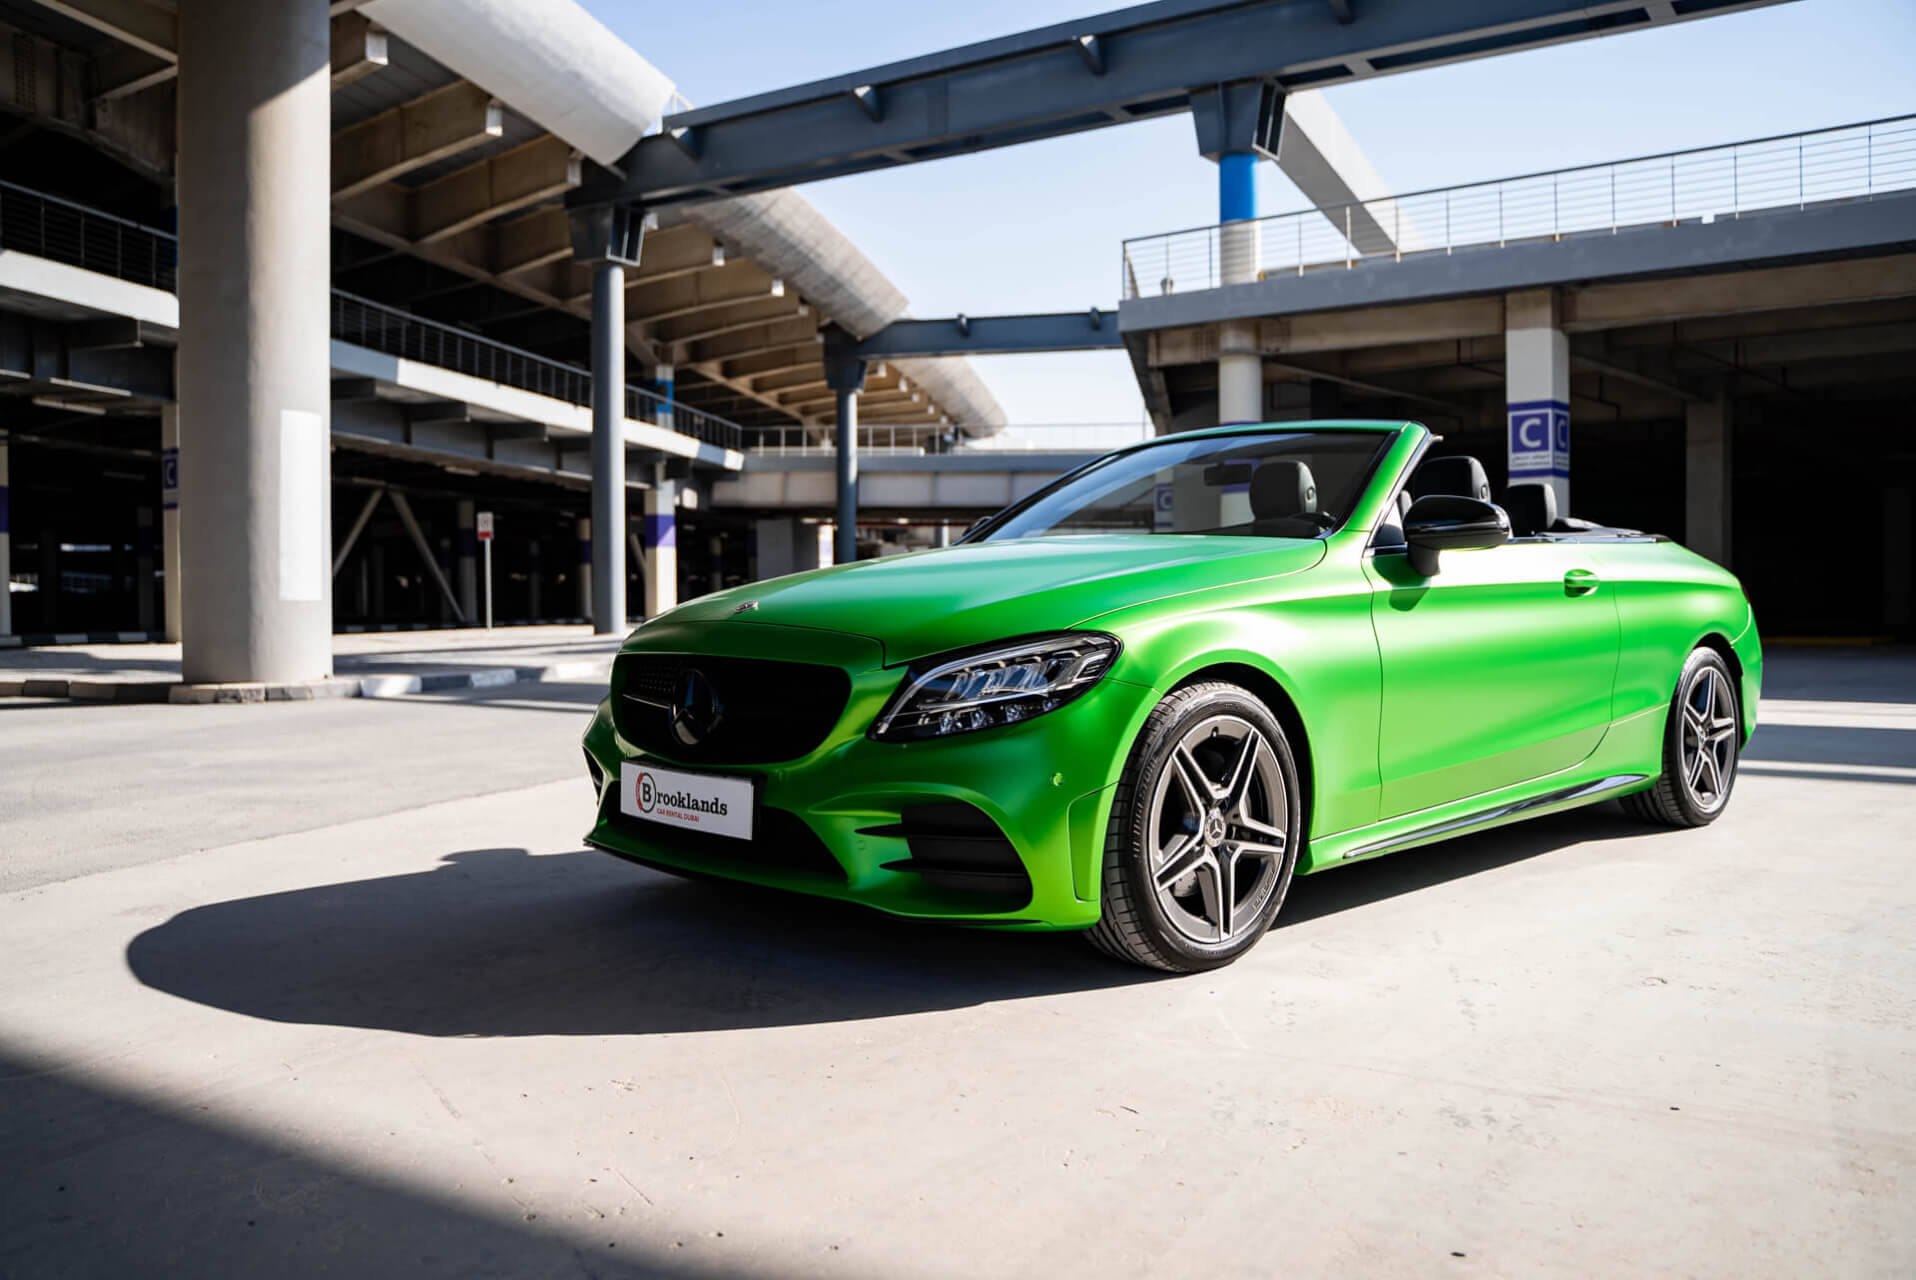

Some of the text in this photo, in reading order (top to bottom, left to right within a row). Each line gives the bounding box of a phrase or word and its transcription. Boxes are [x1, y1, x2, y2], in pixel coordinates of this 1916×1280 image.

[1519, 417, 1542, 448] C
[641, 782, 728, 816] Brooklands
[656, 807, 700, 823] CAR RENTAL DUBAI
